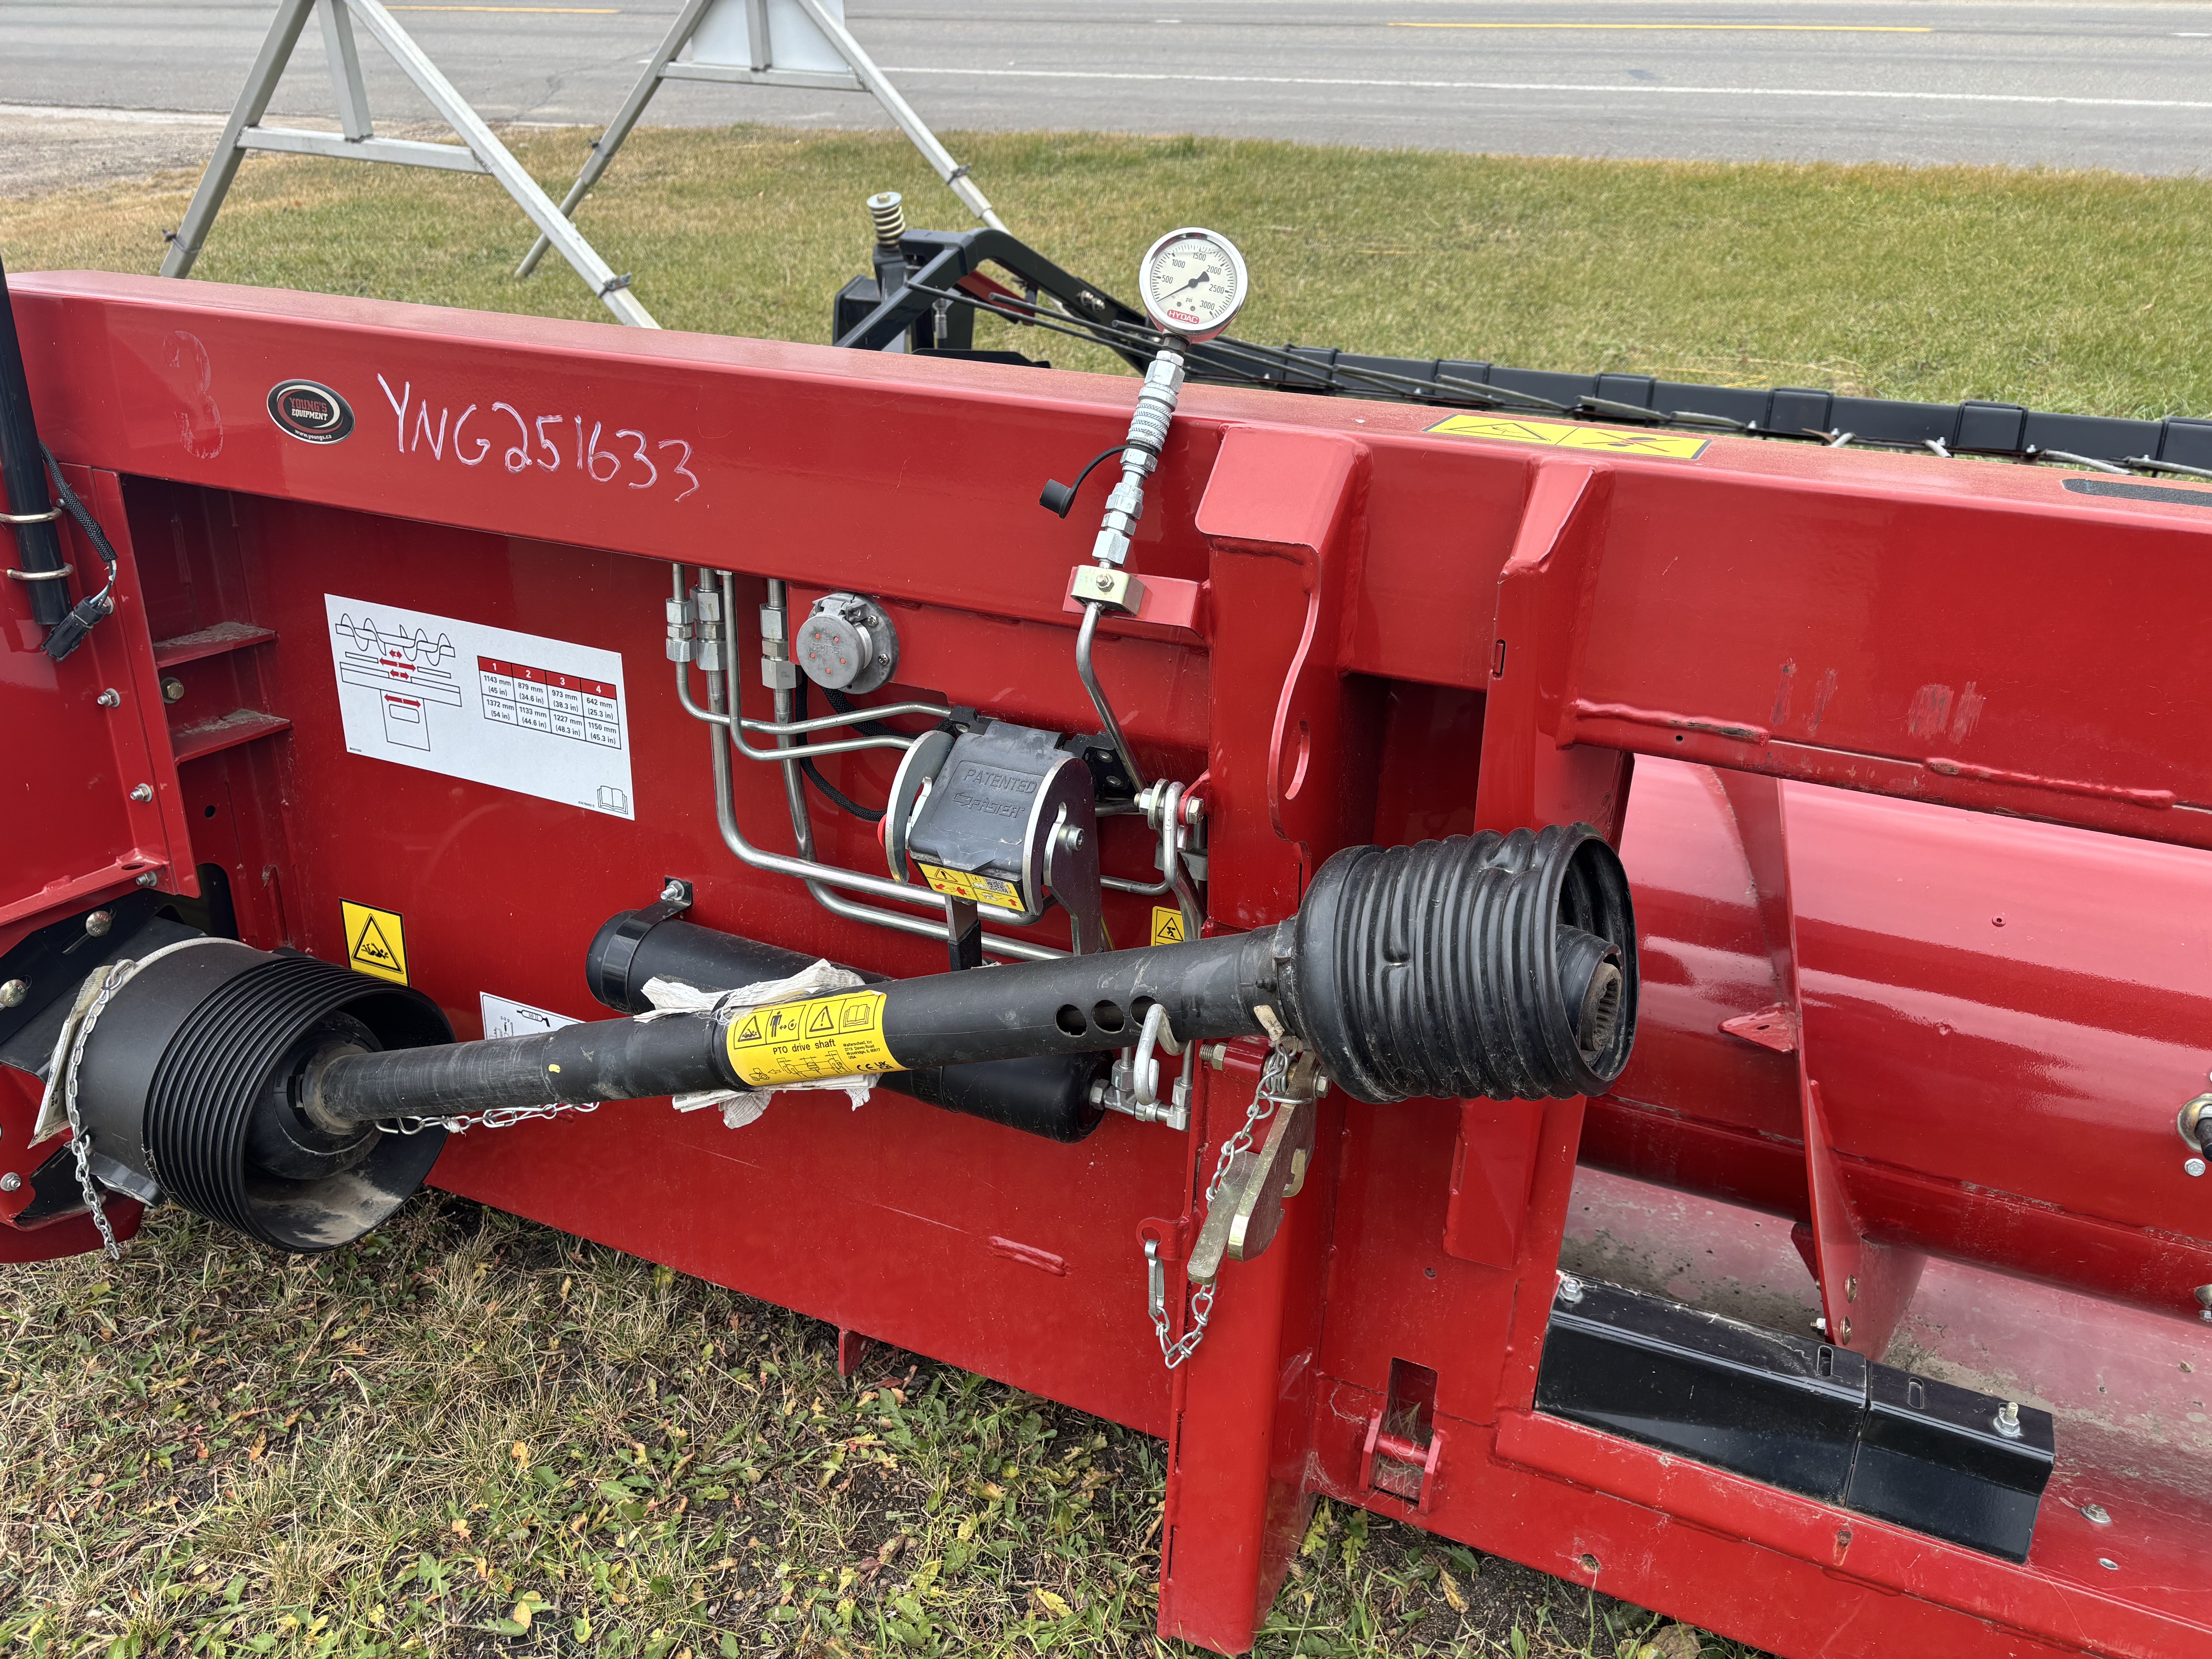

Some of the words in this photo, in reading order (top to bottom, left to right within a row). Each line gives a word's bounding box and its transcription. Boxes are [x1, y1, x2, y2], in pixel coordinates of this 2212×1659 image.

[1193, 253, 1206, 261] 1500
[1172, 259, 1185, 268] 1000
[1206, 265, 1221, 275] 2000
[1162, 275, 1173, 284] 500
[1209, 284, 1224, 294] 2500
[1199, 300, 1215, 310] 3000
[1168, 311, 1198, 323] HYDAC
[289, 397, 328, 413] YOUNG'S
[292, 409, 328, 421] EQUIPMENT
[294, 429, 332, 441] www.youngs.ca
[377, 373, 699, 503] YNG251633
[484, 675, 497, 683] 1143
[493, 663, 496, 671] 1
[526, 670, 531, 678] 2
[560, 677, 565, 685] 3
[596, 685, 601, 693] 4
[499, 688, 507, 697] in)
[519, 692, 534, 701] (34.6
[536, 696, 544, 705] in)
[486, 699, 500, 708] 1372
[553, 700, 568, 709] (38.3
[570, 704, 578, 713] in)
[519, 706, 532, 715] 1133
[588, 708, 603, 717] (25.3
[605, 711, 613, 720] in)
[522, 717, 537, 726] (44.6
[539, 720, 547, 729] in)
[553, 714, 568, 723] 1227
[556, 724, 571, 733] (48.3
[572, 728, 580, 737] in)
[588, 722, 602, 730] 1150
[591, 732, 606, 742] (45.3
[608, 736, 616, 745] in)
[963, 769, 1037, 794] PATENTED
[773, 1046, 788, 1054] PTO
[792, 1043, 811, 1052] drive
[815, 1039, 836, 1049] shaft
